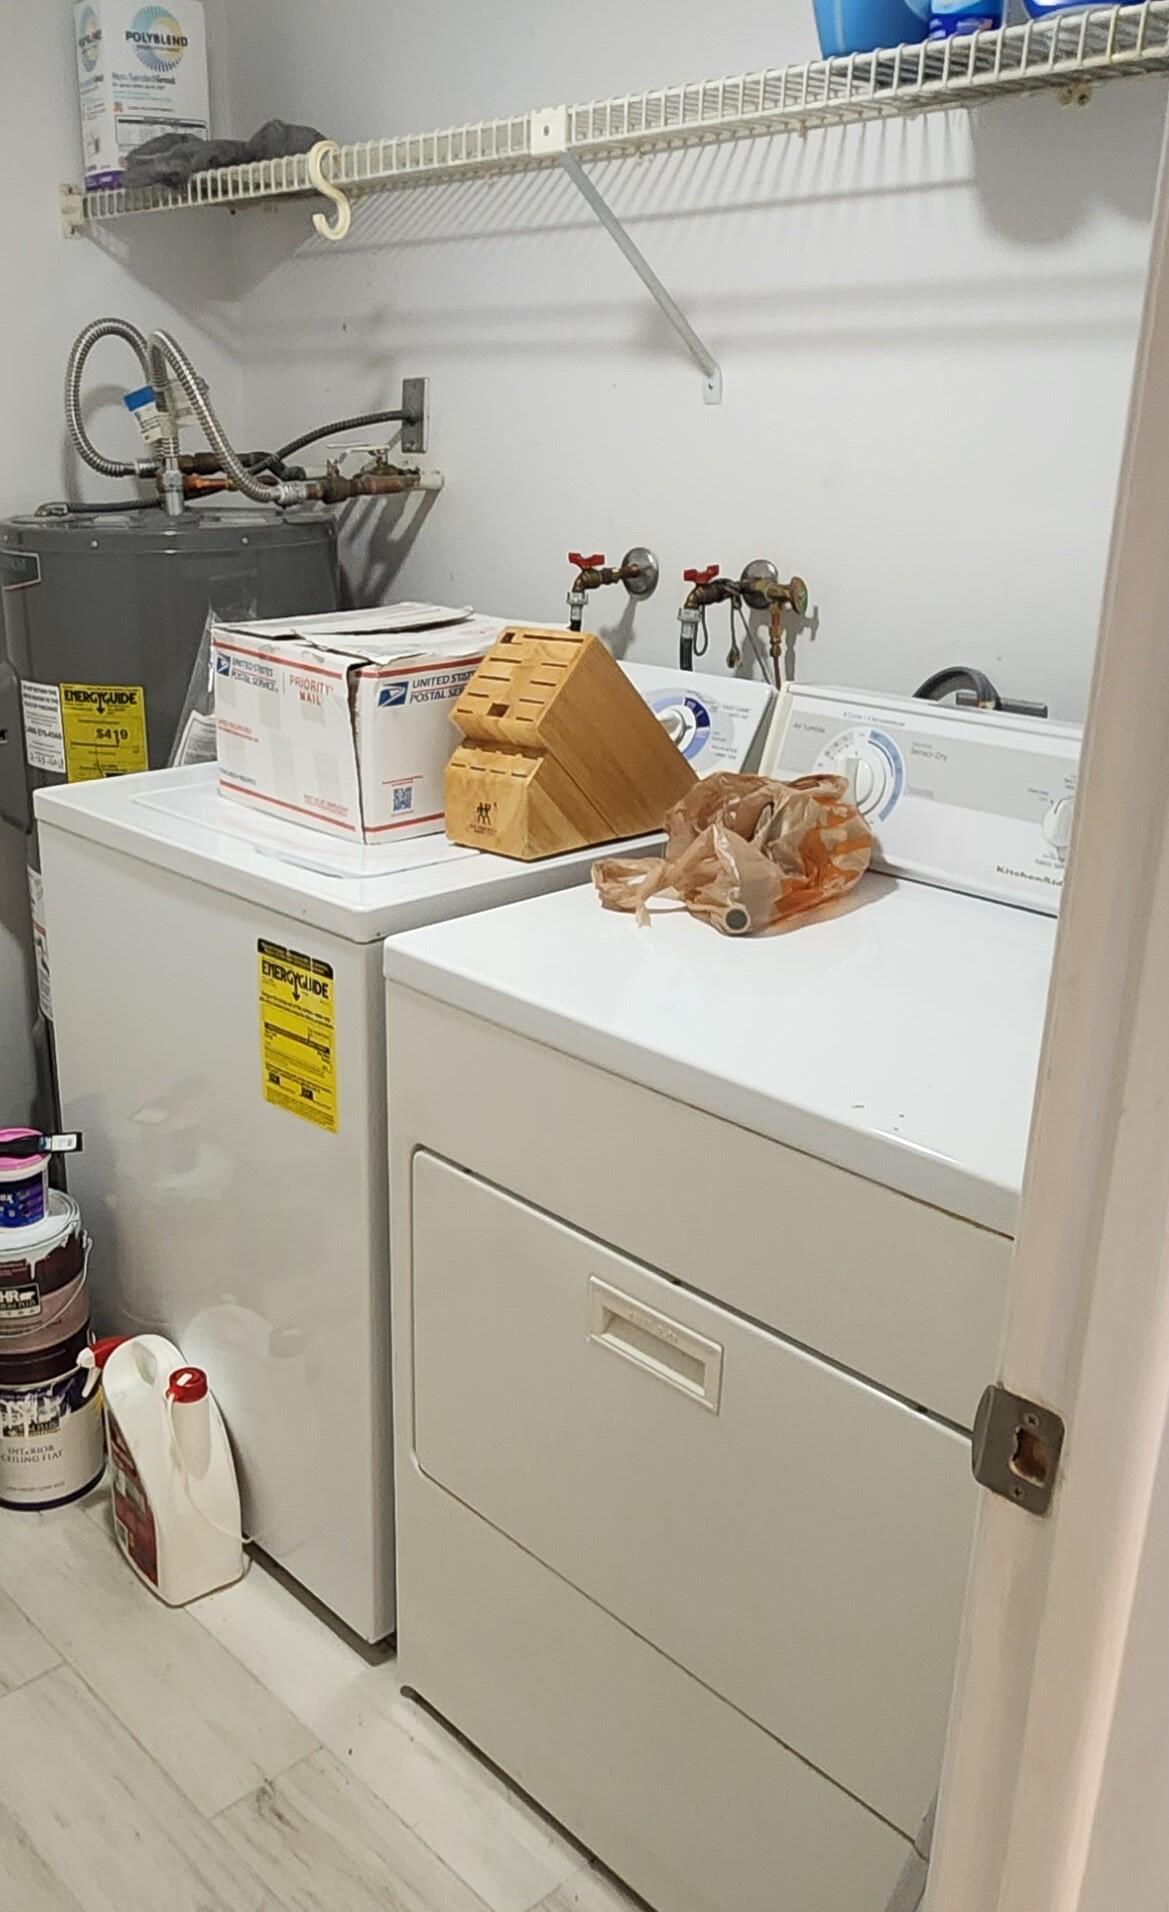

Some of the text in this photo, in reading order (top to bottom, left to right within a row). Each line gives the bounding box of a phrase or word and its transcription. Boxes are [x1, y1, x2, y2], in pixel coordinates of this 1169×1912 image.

[125, 30, 188, 47] POLYBLEND
[289, 674, 331, 695] PRIORITY
[412, 676, 450, 689] UNITED
[64, 690, 138, 705] ENERGYGUIDE
[299, 690, 321, 706] MAIL
[409, 689, 446, 704] POSTAL
[997, 865, 1064, 887] KitchenAid
[262, 959, 329, 999] ENERGYGUIDE
[0, 1289, 19, 1303] HR
